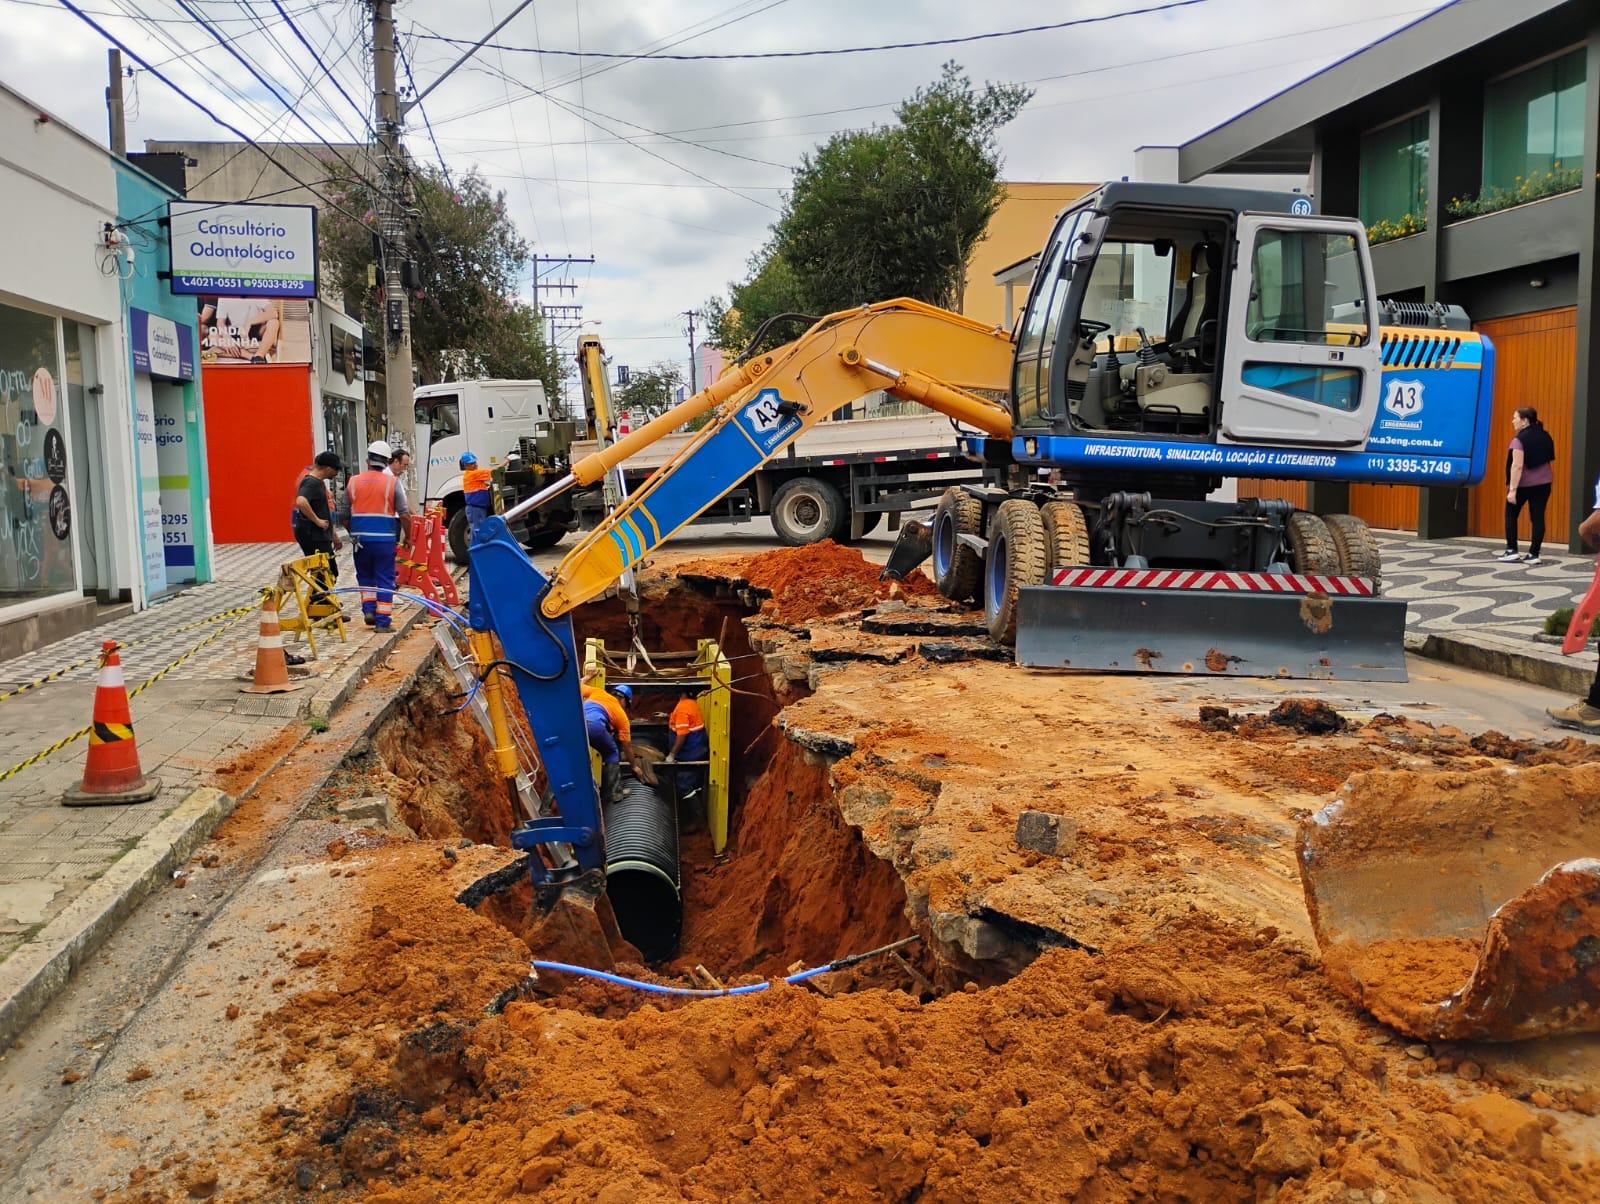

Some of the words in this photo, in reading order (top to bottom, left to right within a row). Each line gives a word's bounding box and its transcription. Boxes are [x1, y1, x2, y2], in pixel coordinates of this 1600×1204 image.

[1294, 203, 1307, 216] 68
[198, 219, 286, 238] Consultório
[190, 241, 295, 263] Odontológico
[190, 277, 241, 288] 4021-0551
[251, 278, 304, 289] 95033-8295
[208, 326, 246, 336] ONDA
[1392, 386, 1416, 409] A3
[755, 400, 779, 428] A3
[770, 421, 797, 443] ENGENHARIA
[1384, 421, 1420, 429] ENGENHARIA
[1084, 444, 1163, 461] INFRAESTRUTURA,
[1166, 448, 1224, 463] SINALIZAÇÃO,
[1226, 450, 1266, 466] LOCAÇÃO
[1267, 453, 1274, 464] E
[1275, 453, 1337, 467] LOTEAMENTOS
[1368, 458, 1384, 469] (11)
[1387, 458, 1452, 474] 3395-3749
[161, 514, 188, 525] 8295
